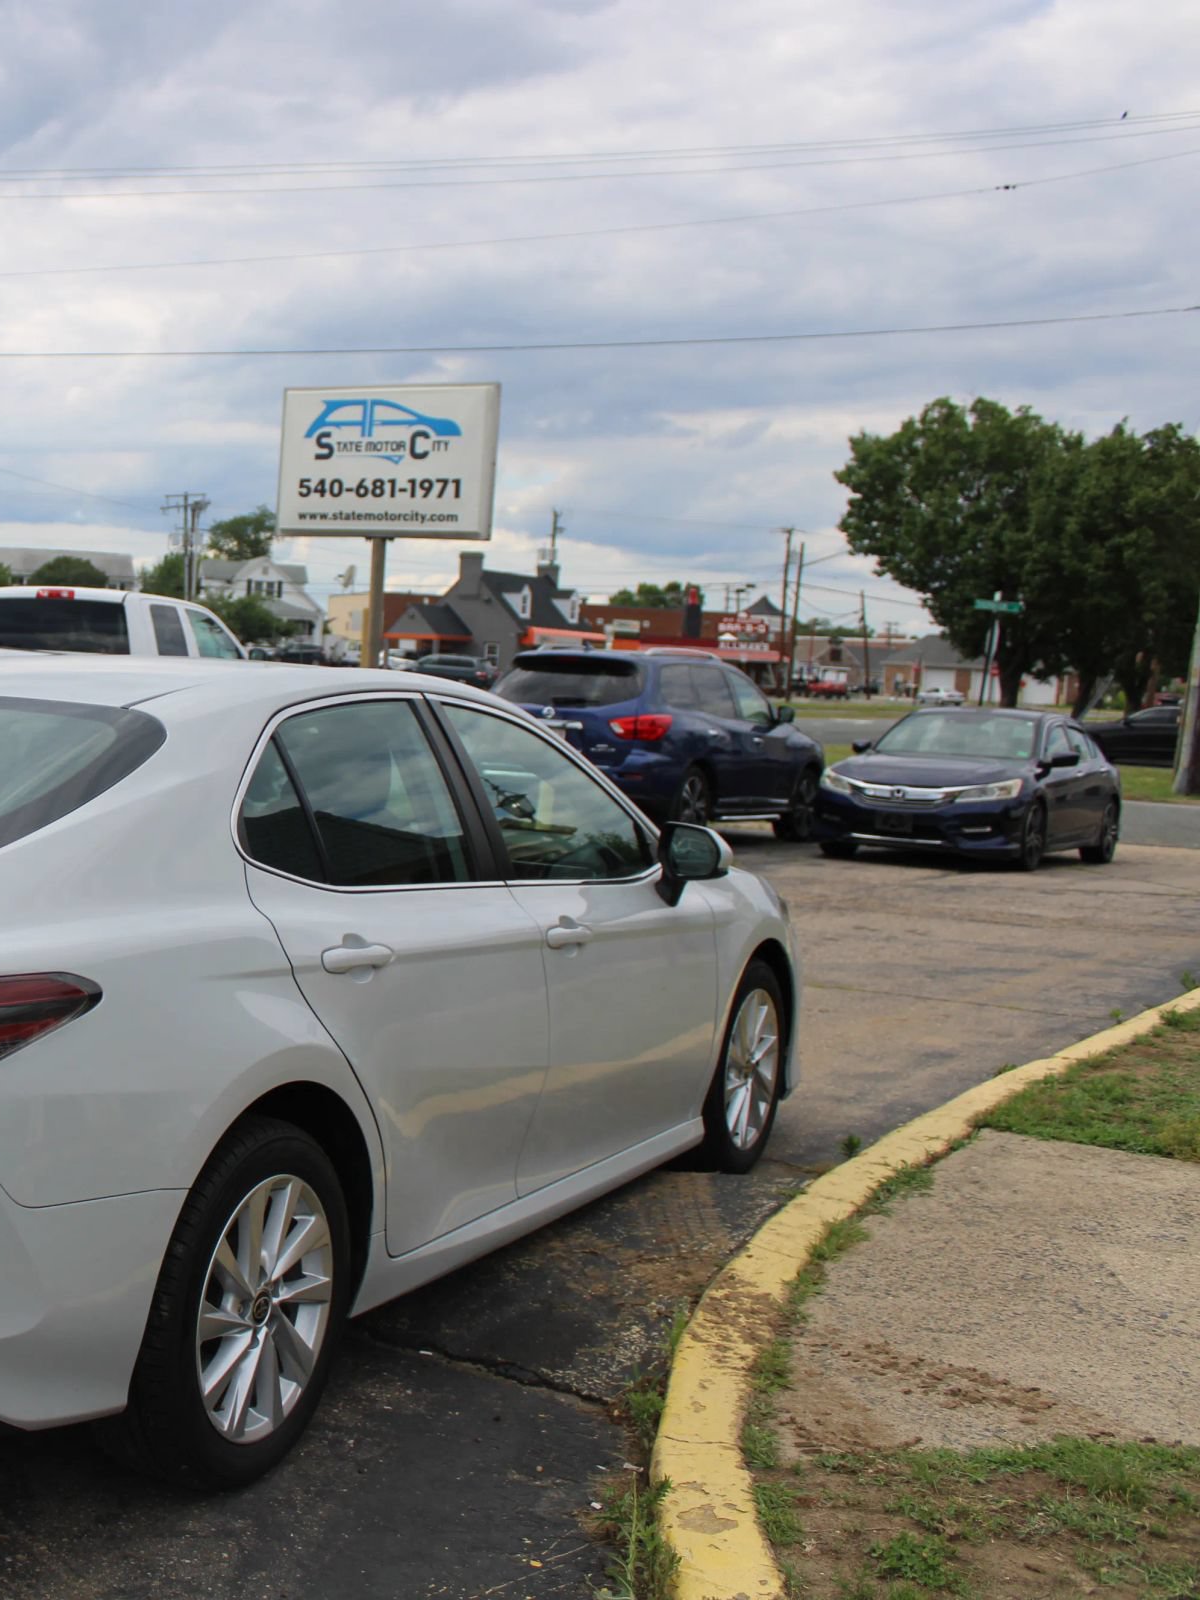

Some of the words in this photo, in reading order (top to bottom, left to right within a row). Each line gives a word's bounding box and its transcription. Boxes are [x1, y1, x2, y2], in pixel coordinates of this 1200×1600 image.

[314, 431, 363, 460] STATE
[365, 440, 406, 453] MOTOR
[409, 429, 450, 460] CITY
[298, 477, 462, 499] 540-681-1971
[298, 510, 459, 525] www.statemotorcity.com
